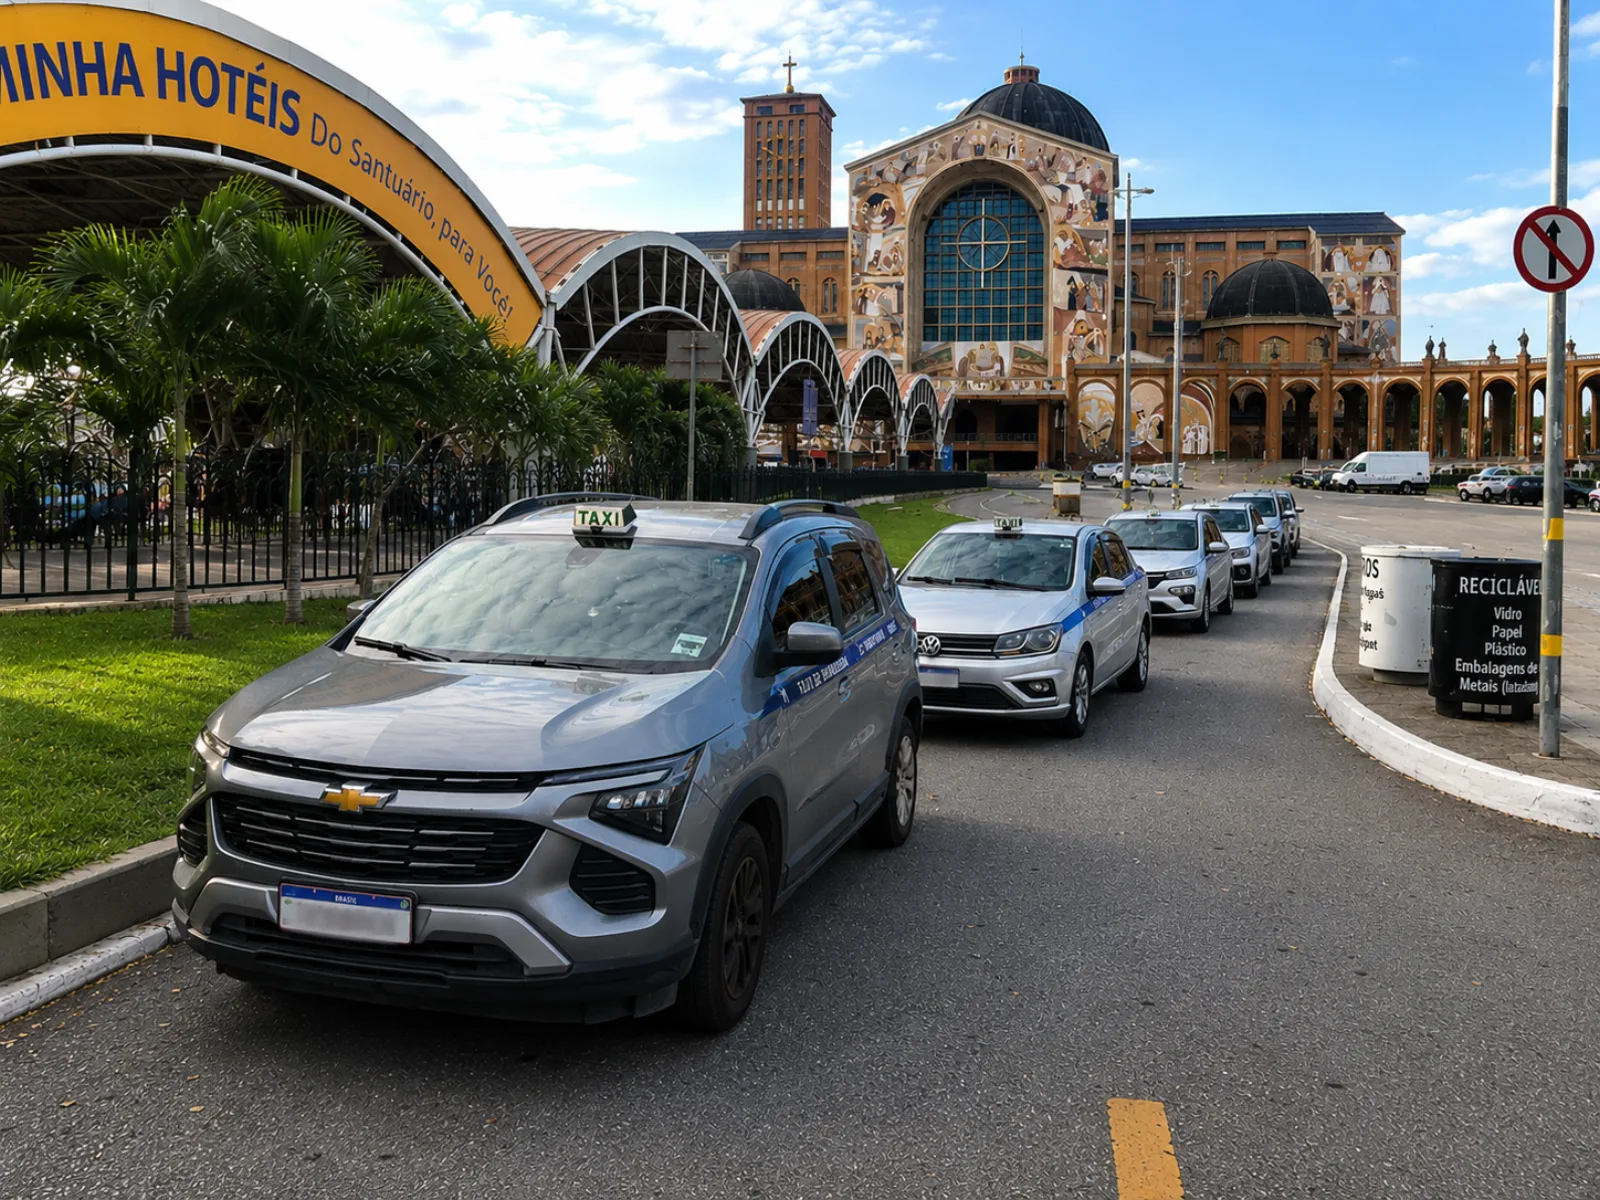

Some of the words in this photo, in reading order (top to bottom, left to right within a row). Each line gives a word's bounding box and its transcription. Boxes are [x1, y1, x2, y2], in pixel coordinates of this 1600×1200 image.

[156, 47, 300, 136] HOTÉIS
[311, 112, 341, 155] Do
[349, 138, 435, 229] Santuário,
[438, 217, 474, 266] para
[578, 510, 619, 526] TAXI
[1493, 606, 1522, 620] Vidro
[1492, 624, 1522, 641] Papel
[1484, 642, 1527, 656] Plástico
[1455, 657, 1525, 678] Embalagens
[1459, 676, 1498, 693] Metais
